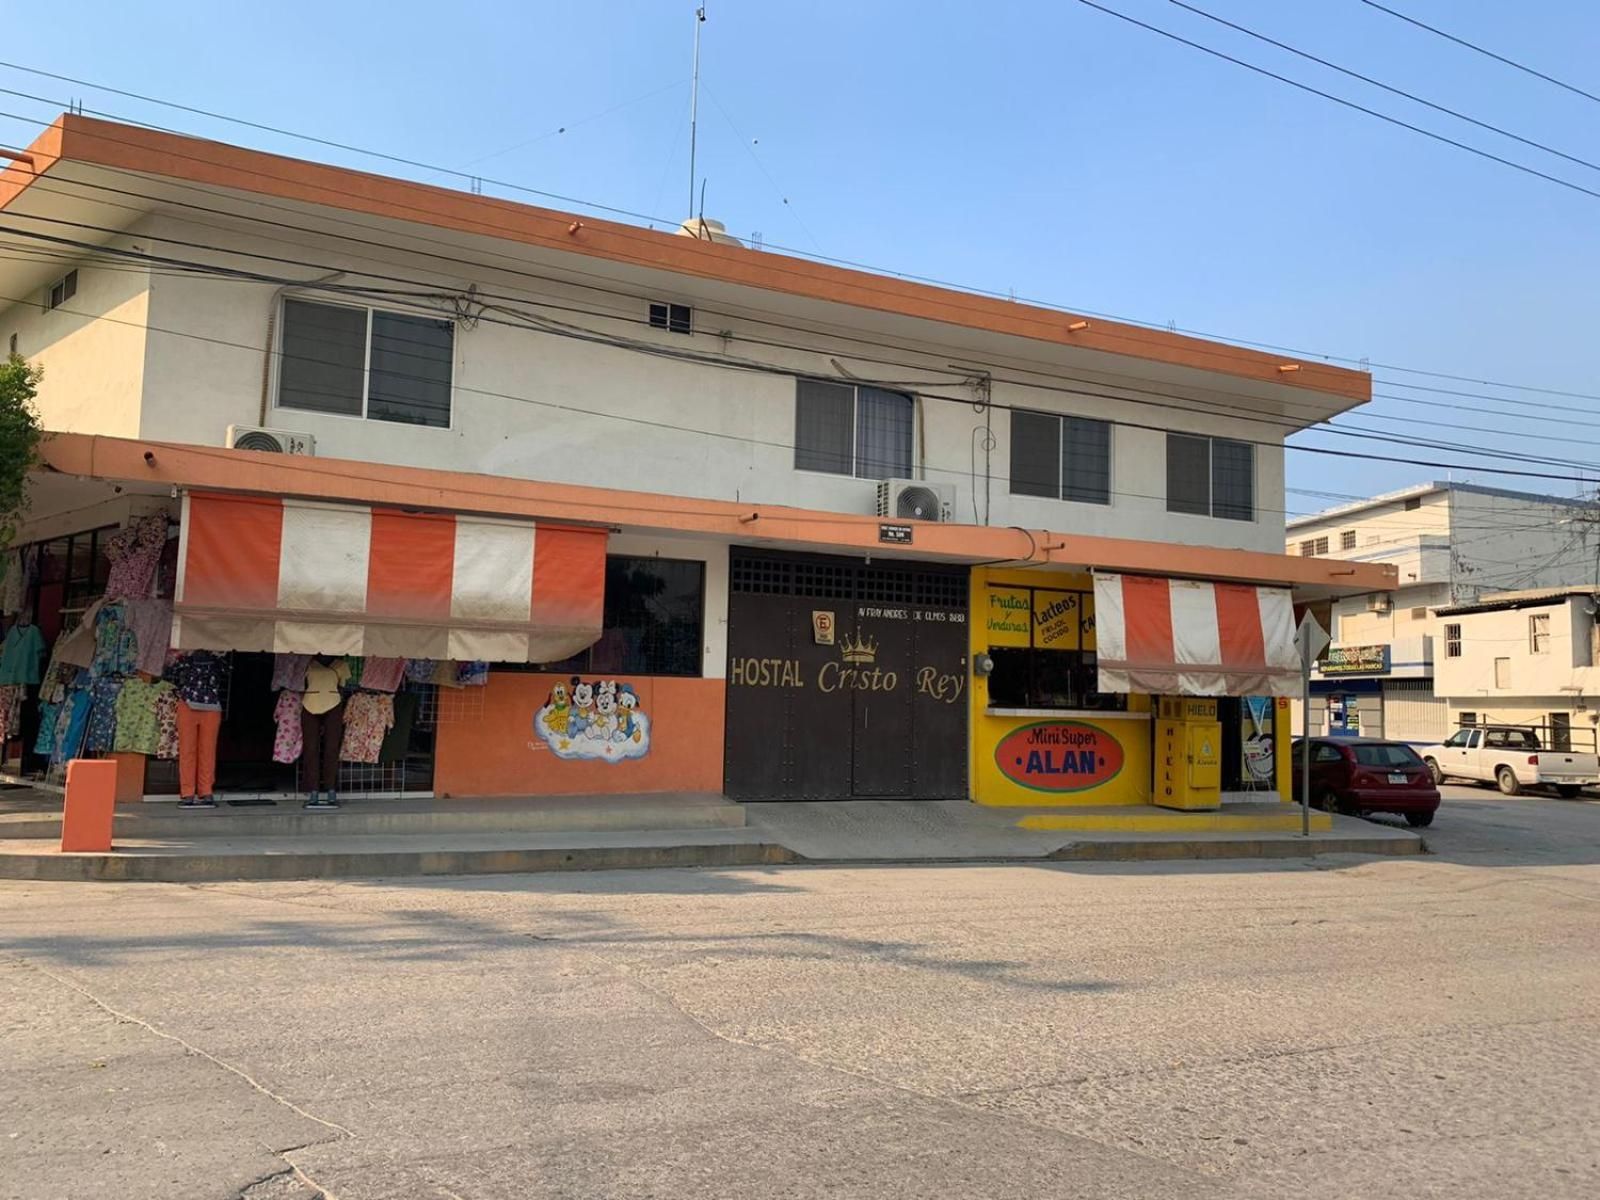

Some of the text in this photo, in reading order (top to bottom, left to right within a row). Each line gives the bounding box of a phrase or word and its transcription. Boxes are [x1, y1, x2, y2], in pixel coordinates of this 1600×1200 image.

[990, 594, 1030, 610] Frutas
[1034, 595, 1077, 626] Lacteos
[1043, 625, 1069, 644] COCIDO
[731, 657, 965, 703] HOSTAL Cristo Rey
[1188, 703, 1216, 716] HIELO
[1027, 728, 1097, 749] Mini Super
[1025, 750, 1096, 774] ALAN
[1165, 727, 1174, 796] HIELO
